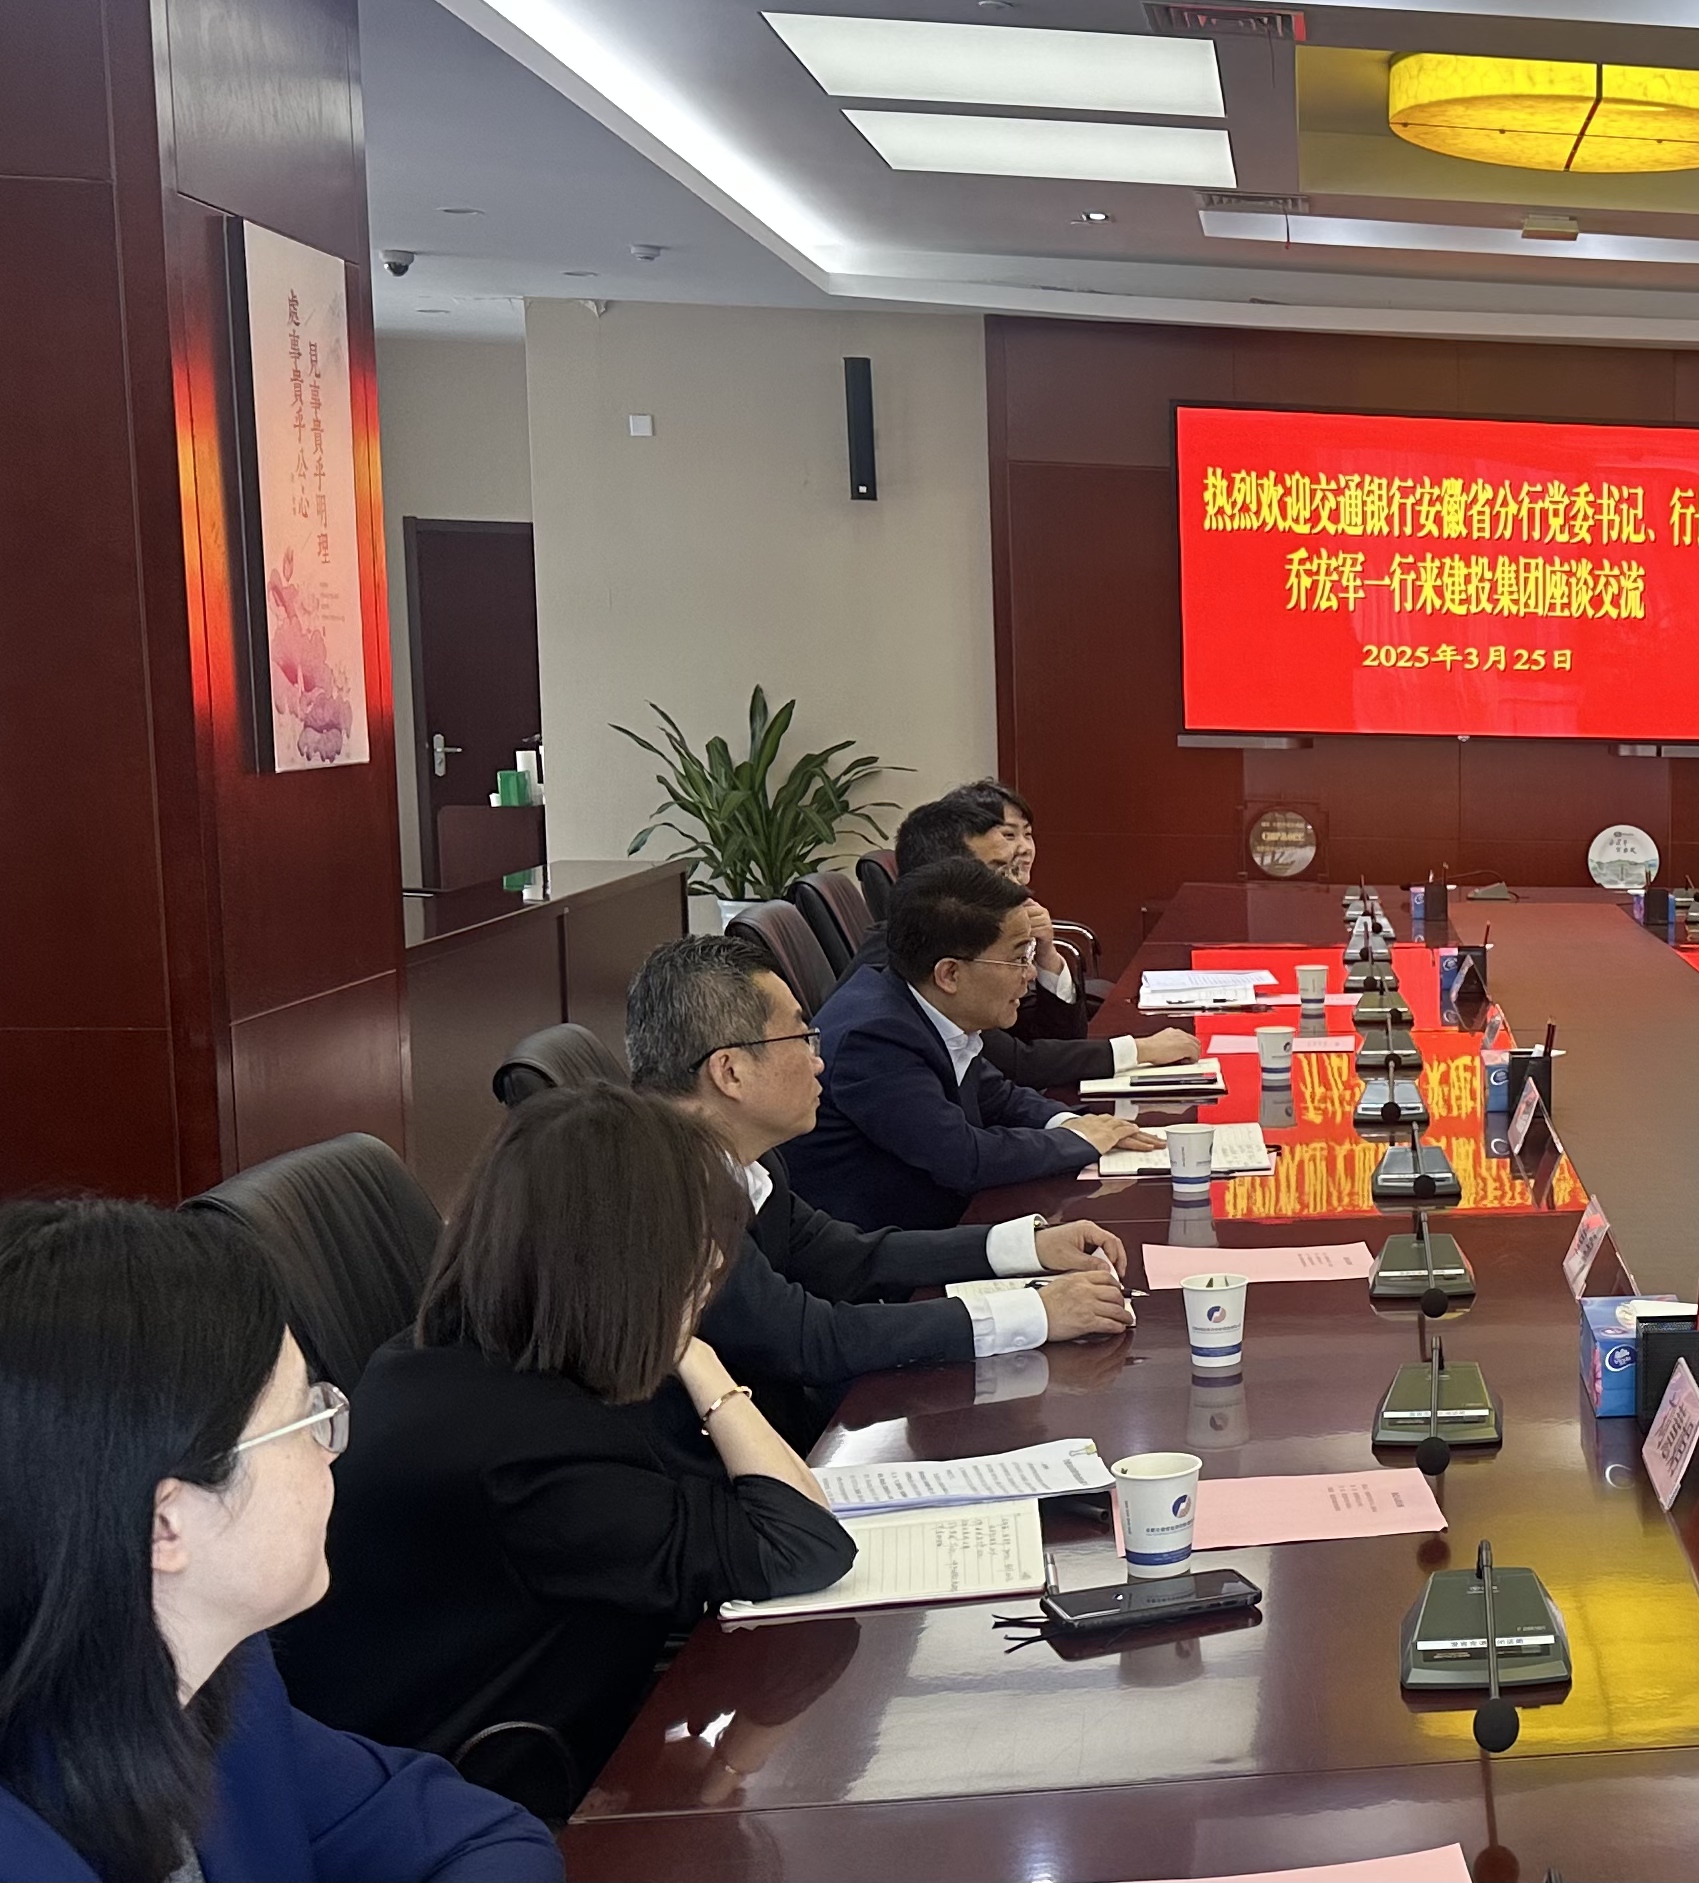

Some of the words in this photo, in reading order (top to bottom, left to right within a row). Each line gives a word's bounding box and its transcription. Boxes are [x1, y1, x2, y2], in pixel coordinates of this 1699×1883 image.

[286, 288, 310, 518] 處事貴乎公心
[308, 340, 331, 564] 見事貴乎明理
[1285, 546, 1645, 620] 乔宏军一行来建投集团座谈交流
[1362, 643, 1573, 673] 2025年3月25日
